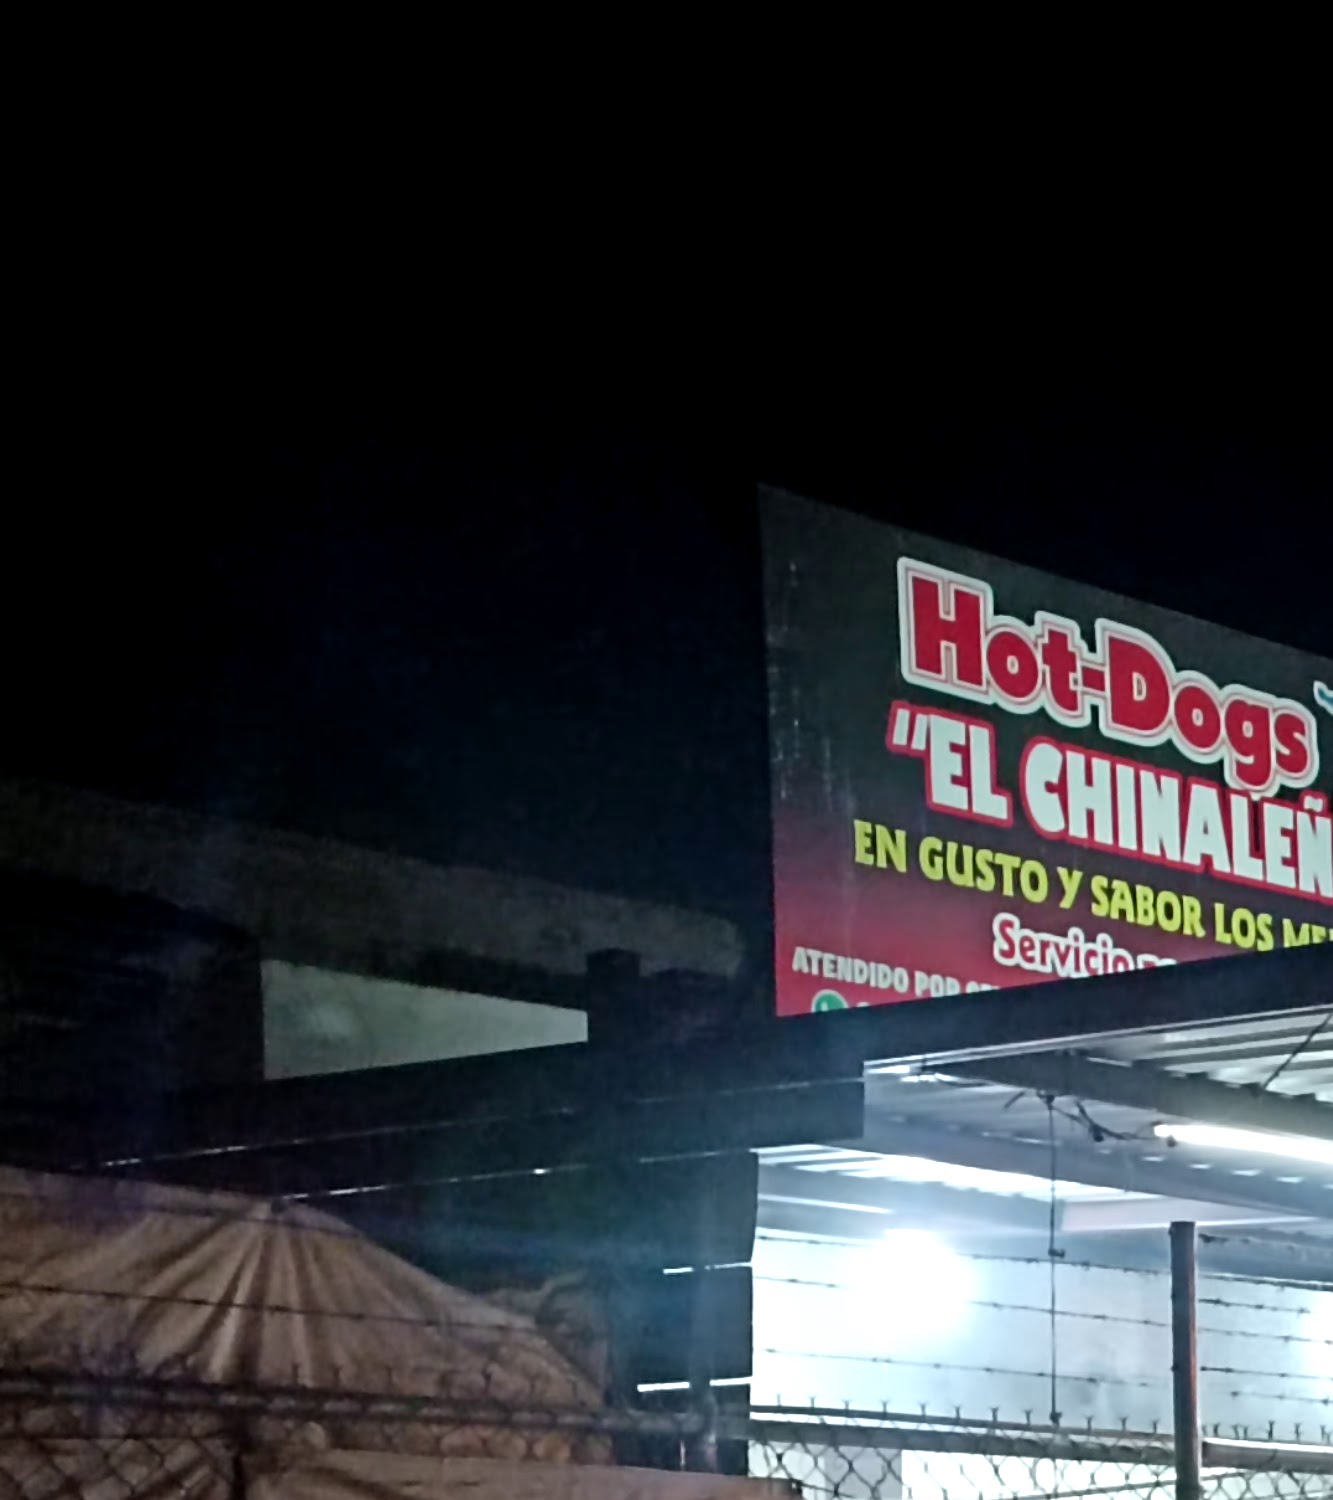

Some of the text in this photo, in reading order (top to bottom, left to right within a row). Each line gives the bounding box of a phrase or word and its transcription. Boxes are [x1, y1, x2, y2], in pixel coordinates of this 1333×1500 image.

[897, 557, 1319, 794] Hot-Dogs
[853, 819, 907, 873] EN
[918, 836, 1049, 904] GUSTO
[1090, 876, 1206, 938] SABOR
[1213, 902, 1274, 952] LOS
[791, 945, 910, 994] ATENDIDO
[992, 912, 1135, 979] Servicio
